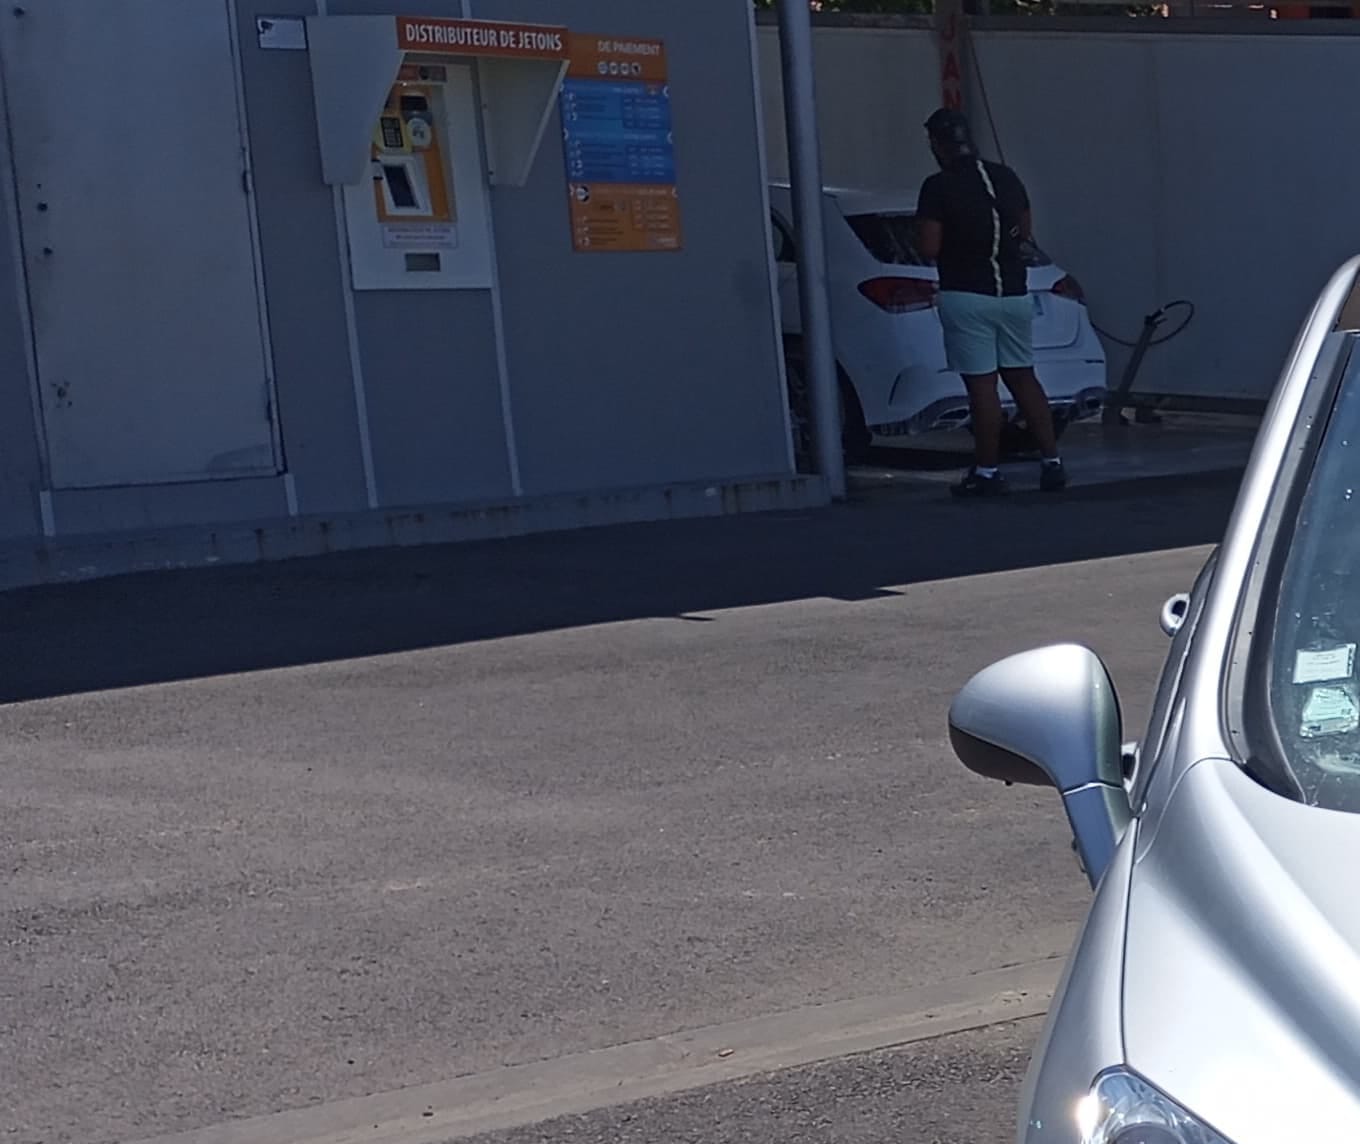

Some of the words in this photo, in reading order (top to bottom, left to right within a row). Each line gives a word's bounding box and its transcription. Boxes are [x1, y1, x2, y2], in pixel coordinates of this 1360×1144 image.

[405, 24, 498, 47] DISTRIBUTEUR
[499, 30, 516, 48] DE
[517, 31, 563, 51] JETONS
[612, 40, 660, 56] PAIEMENT
